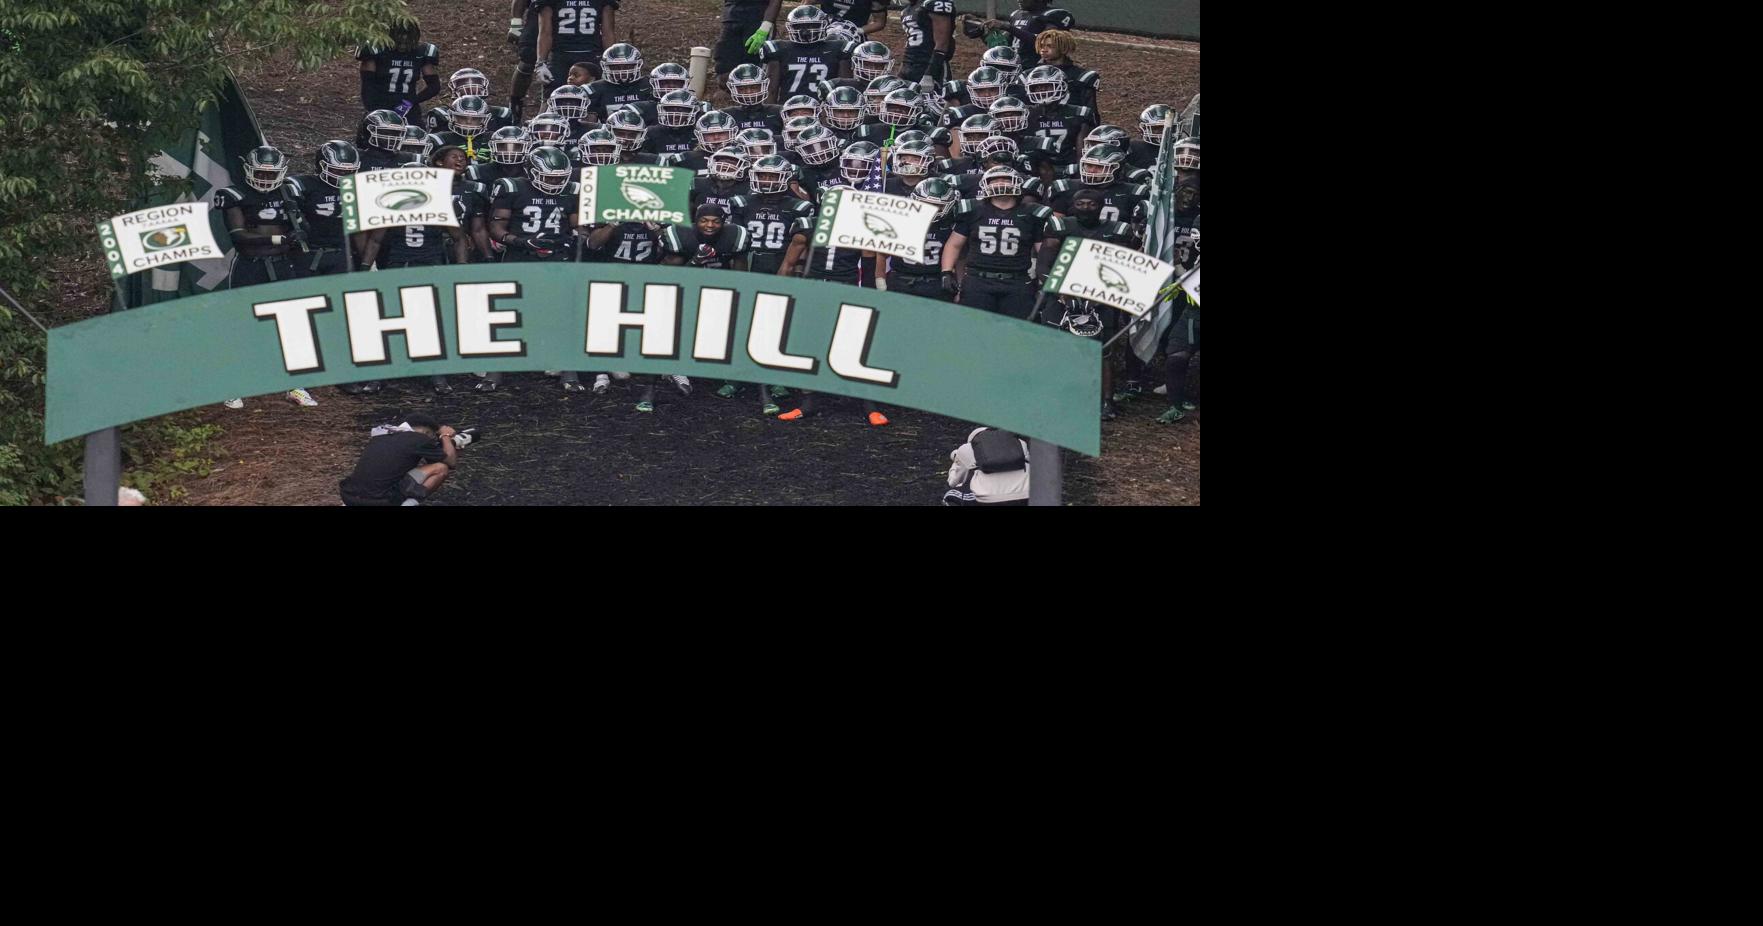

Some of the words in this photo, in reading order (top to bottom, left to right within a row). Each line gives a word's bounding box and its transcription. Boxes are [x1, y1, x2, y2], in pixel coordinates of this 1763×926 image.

[934, 1, 952, 13] 25
[558, 7, 597, 34] 26
[1062, 16, 1070, 27] 4
[788, 64, 829, 92] 73
[943, 113, 950, 125] 5
[366, 170, 437, 184] REGION
[615, 166, 674, 180] STATE
[342, 179, 358, 230] 2013
[583, 171, 593, 221] 2021
[851, 192, 923, 213] REGION
[122, 204, 193, 227] REGION
[368, 212, 448, 226] CHAMPS
[522, 206, 564, 234] 34
[602, 209, 684, 222] CHAMPS
[815, 192, 838, 243] 2020
[748, 221, 785, 248] 20
[838, 235, 917, 256] CHAMPS
[979, 226, 1021, 255] 56
[100, 224, 124, 274] 2004
[133, 245, 212, 268] CHAMPS
[614, 240, 653, 262] 42
[902, 240, 942, 265] 3
[1089, 243, 1160, 270] REGION
[1050, 240, 1077, 289] 2021
[1070, 283, 1147, 312] CHAMPS
[252, 281, 528, 376] THE
[585, 280, 901, 388] HILL
